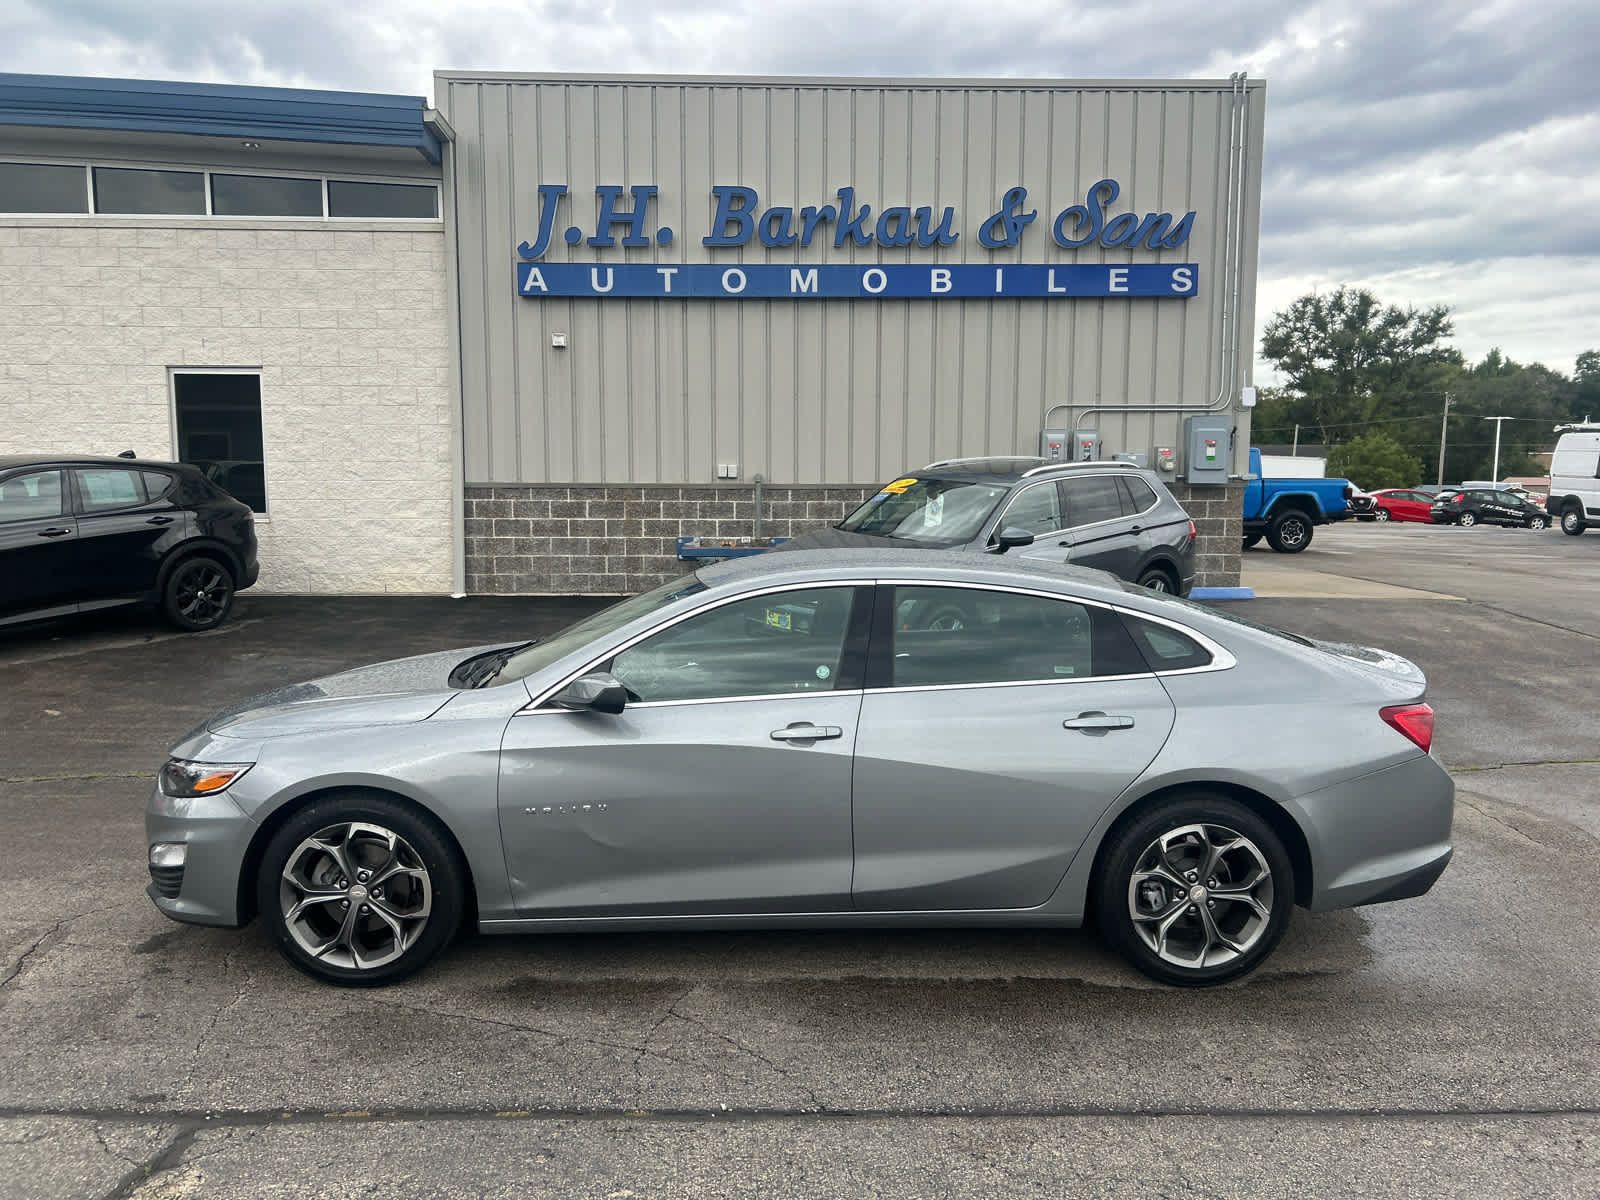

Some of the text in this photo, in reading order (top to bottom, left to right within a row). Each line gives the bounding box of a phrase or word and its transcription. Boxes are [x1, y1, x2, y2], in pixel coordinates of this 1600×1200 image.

[517, 178, 1197, 260] J.H. Barkau & Sons
[523, 266, 1193, 294] AUTOMOBILES
